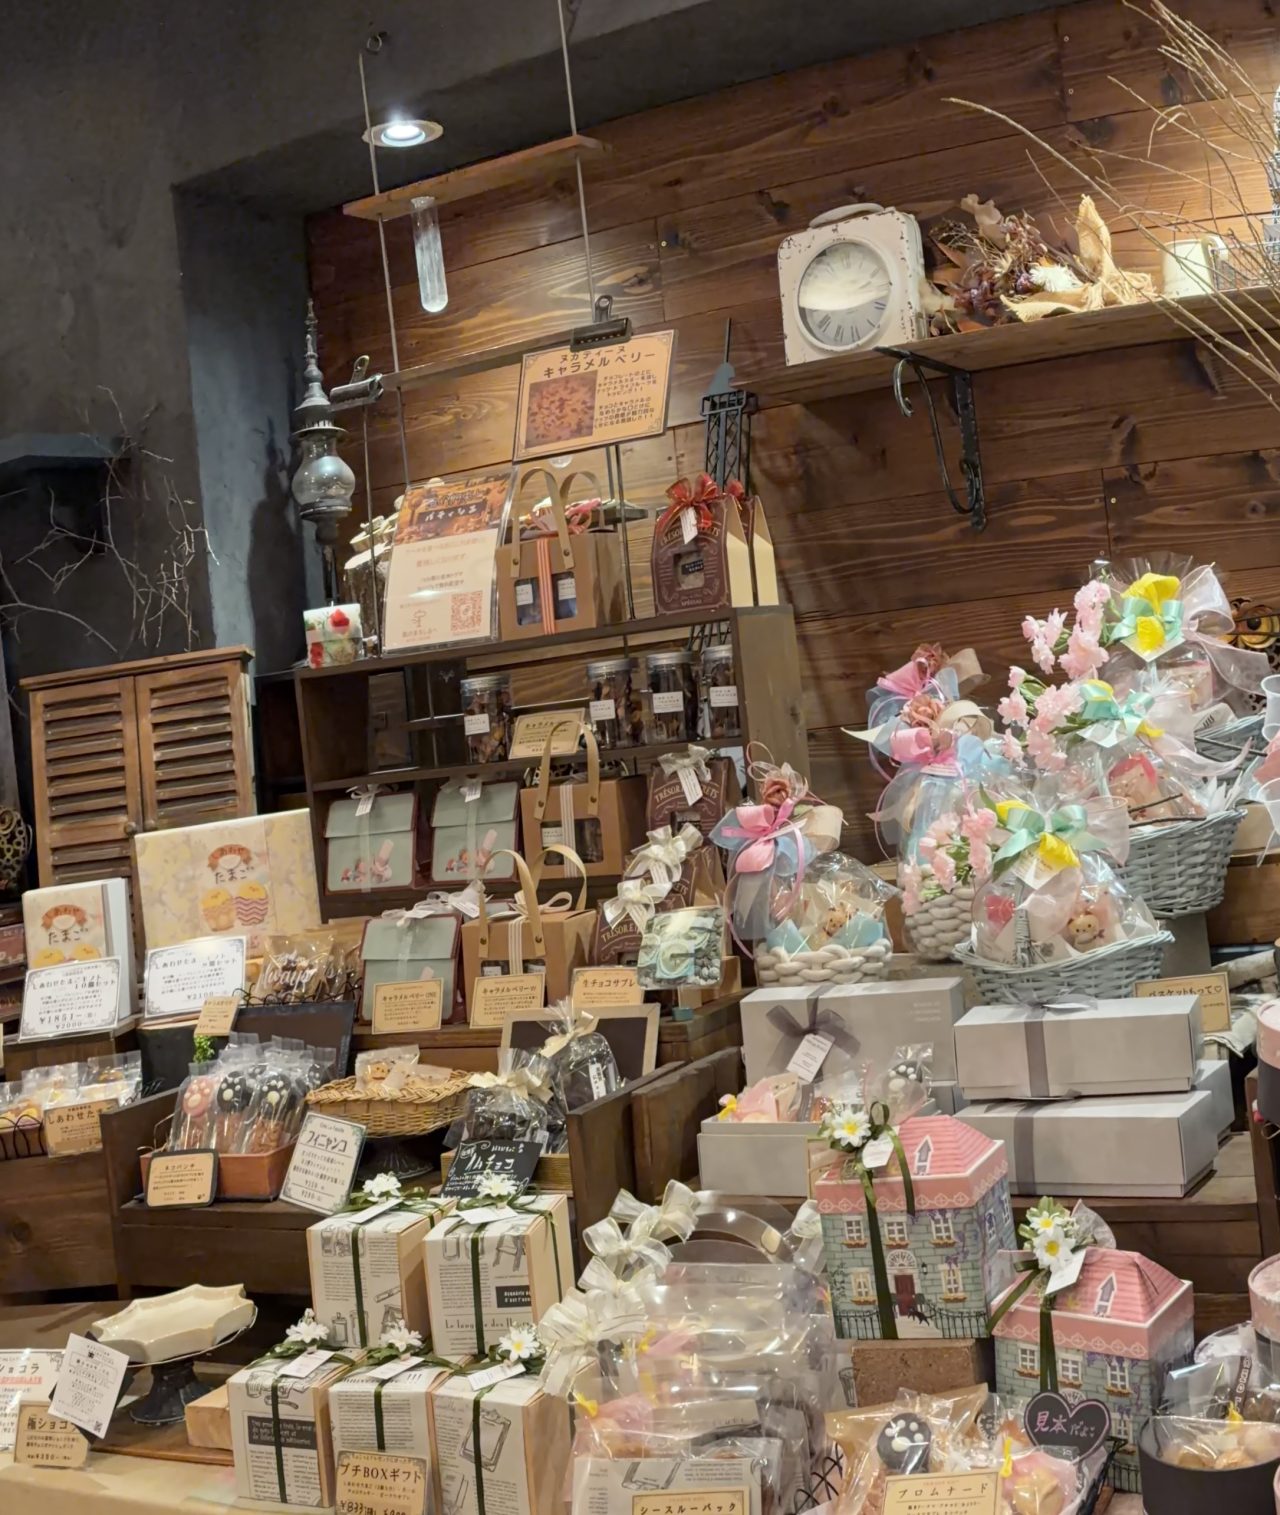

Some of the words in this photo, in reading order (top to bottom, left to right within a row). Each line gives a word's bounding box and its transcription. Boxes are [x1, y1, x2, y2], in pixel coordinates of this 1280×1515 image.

[340, 1462, 422, 1484] プチBOXギフト
[899, 1482, 989, 1499] プロムナード
